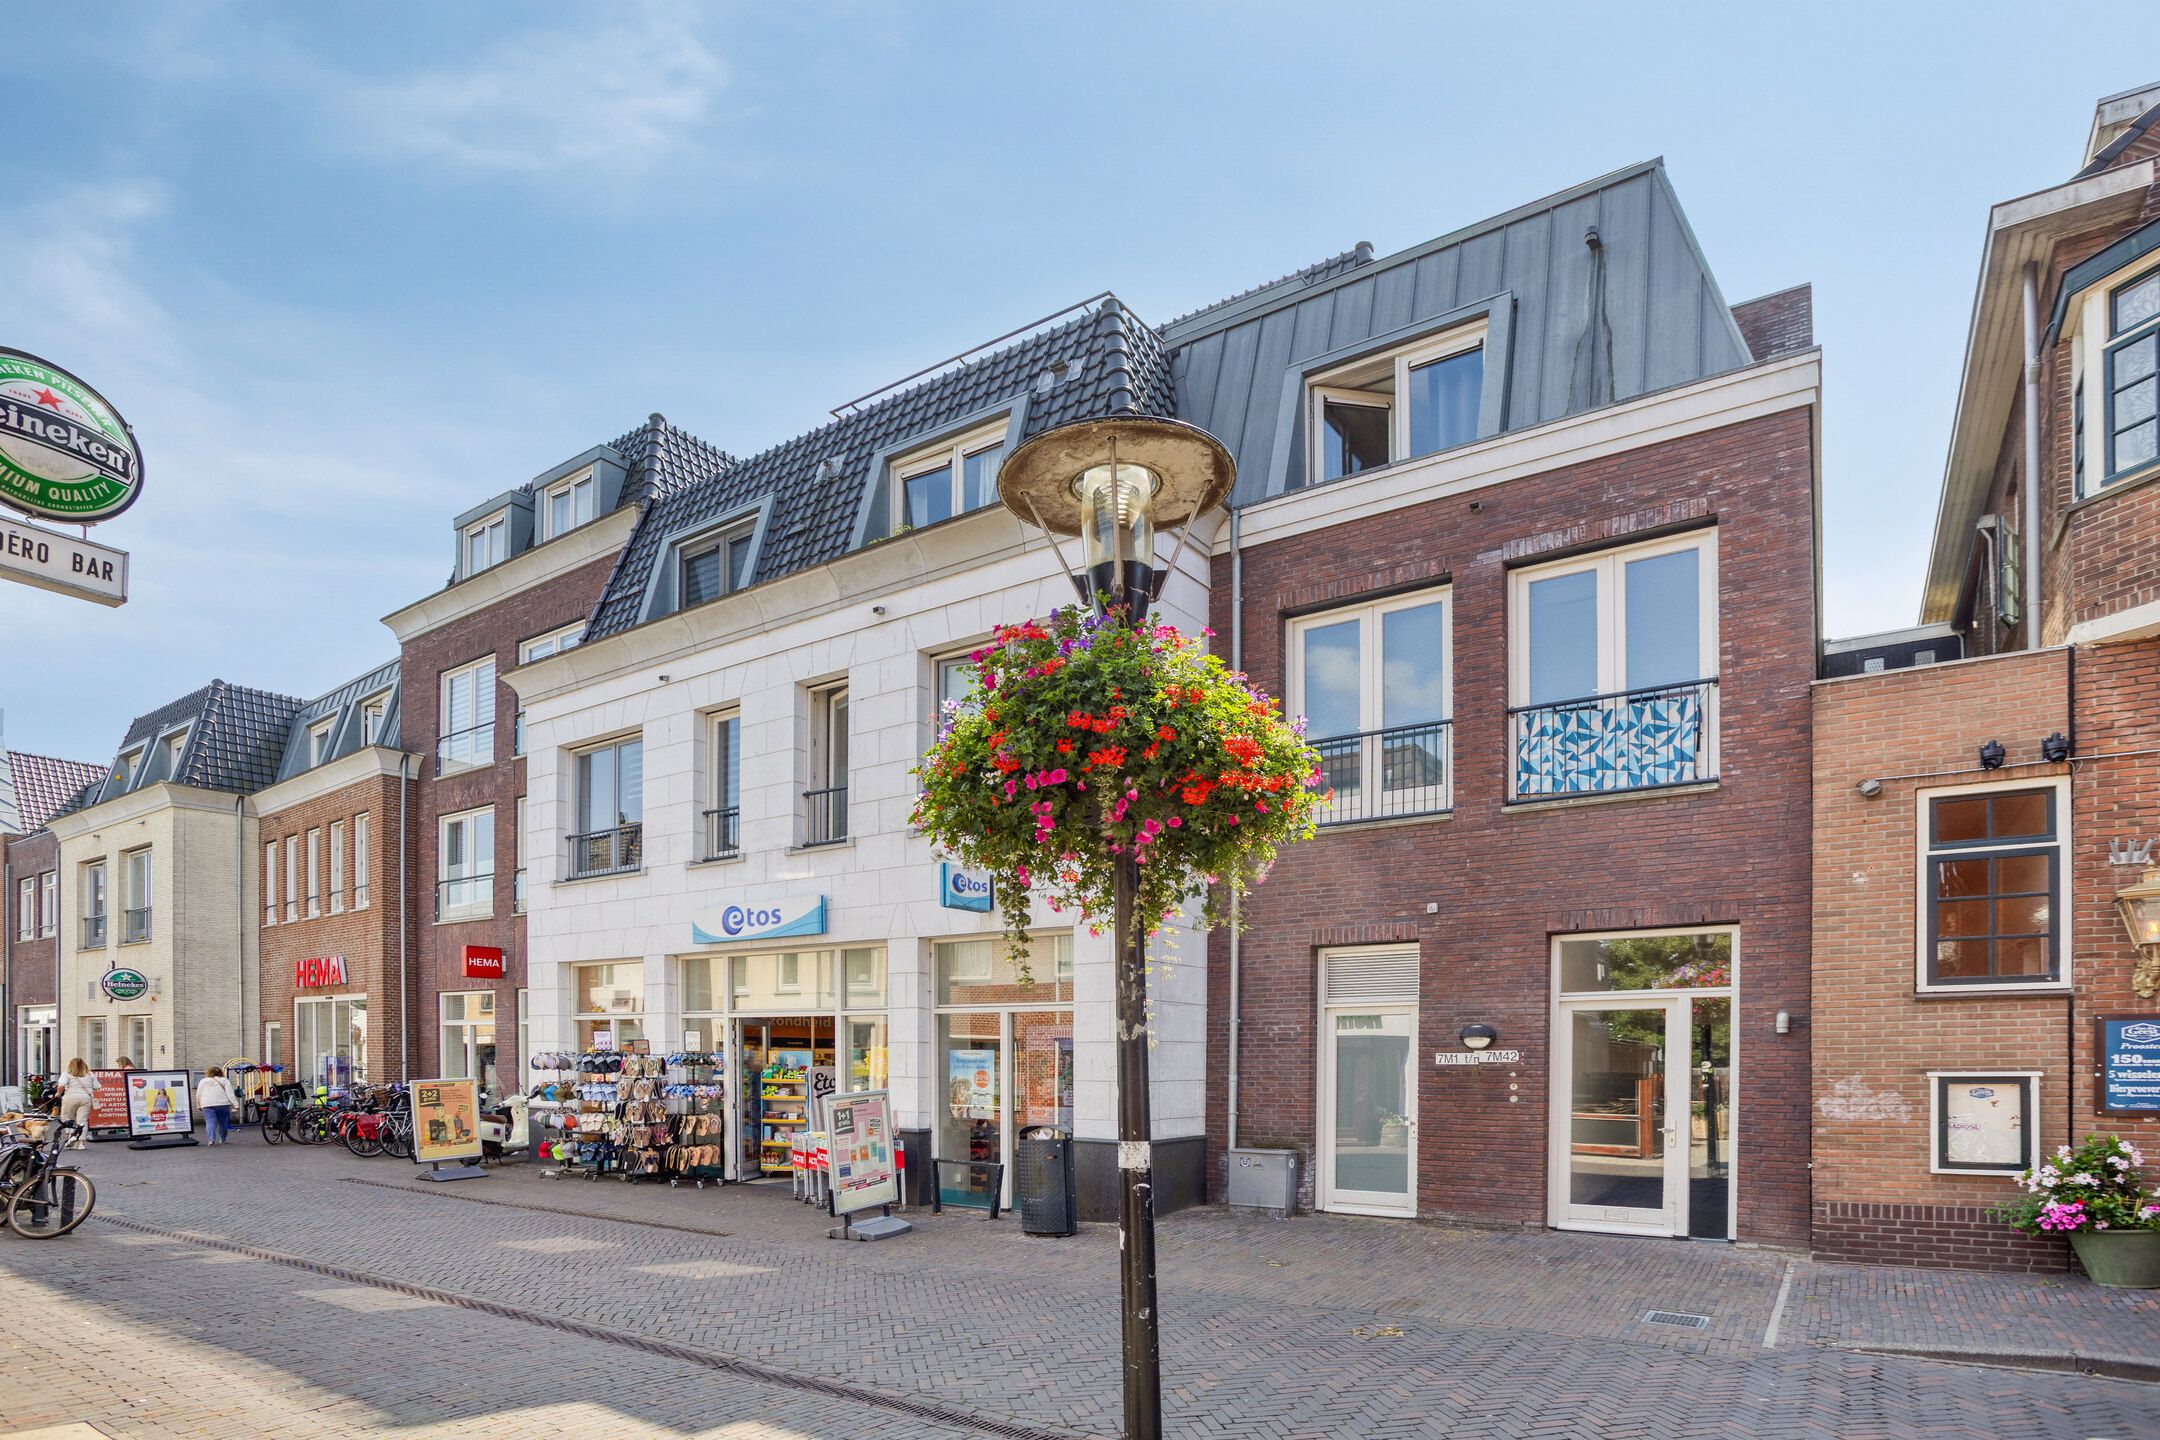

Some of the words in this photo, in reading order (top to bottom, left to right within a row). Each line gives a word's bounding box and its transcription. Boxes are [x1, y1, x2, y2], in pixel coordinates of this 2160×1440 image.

[48, 481, 111, 503] QUALITY
[0, 529, 49, 564] ÉRO
[72, 551, 114, 582] BAR
[468, 957, 500, 968] HEMA
[295, 956, 343, 988] HEMA
[1437, 1054, 1458, 1064] 7M1
[1486, 1051, 1518, 1062] 7M42
[2110, 1054, 2143, 1064] 150
[2108, 1070, 2116, 1079] 5
[837, 1110, 850, 1121] 1+1
